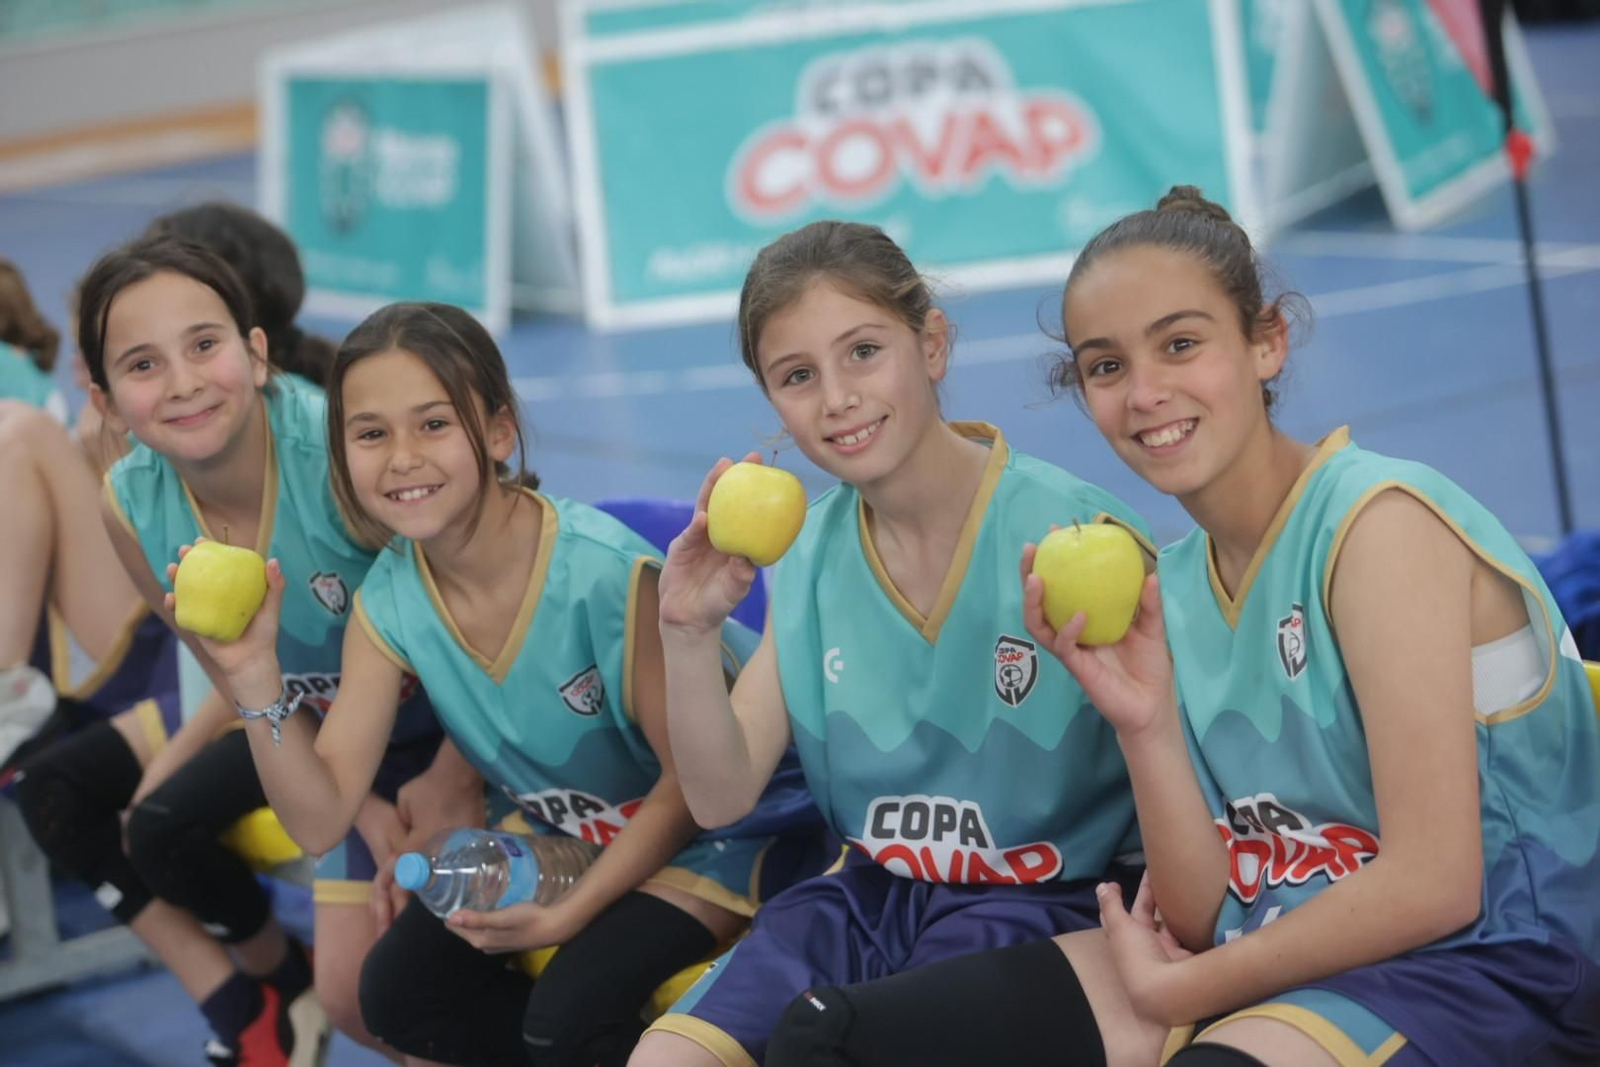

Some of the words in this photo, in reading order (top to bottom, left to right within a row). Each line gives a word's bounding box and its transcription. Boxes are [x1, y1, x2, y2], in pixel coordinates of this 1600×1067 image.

[811, 57, 994, 115] COPA
[737, 98, 1086, 214] COVAP
[870, 801, 989, 849] COPA
